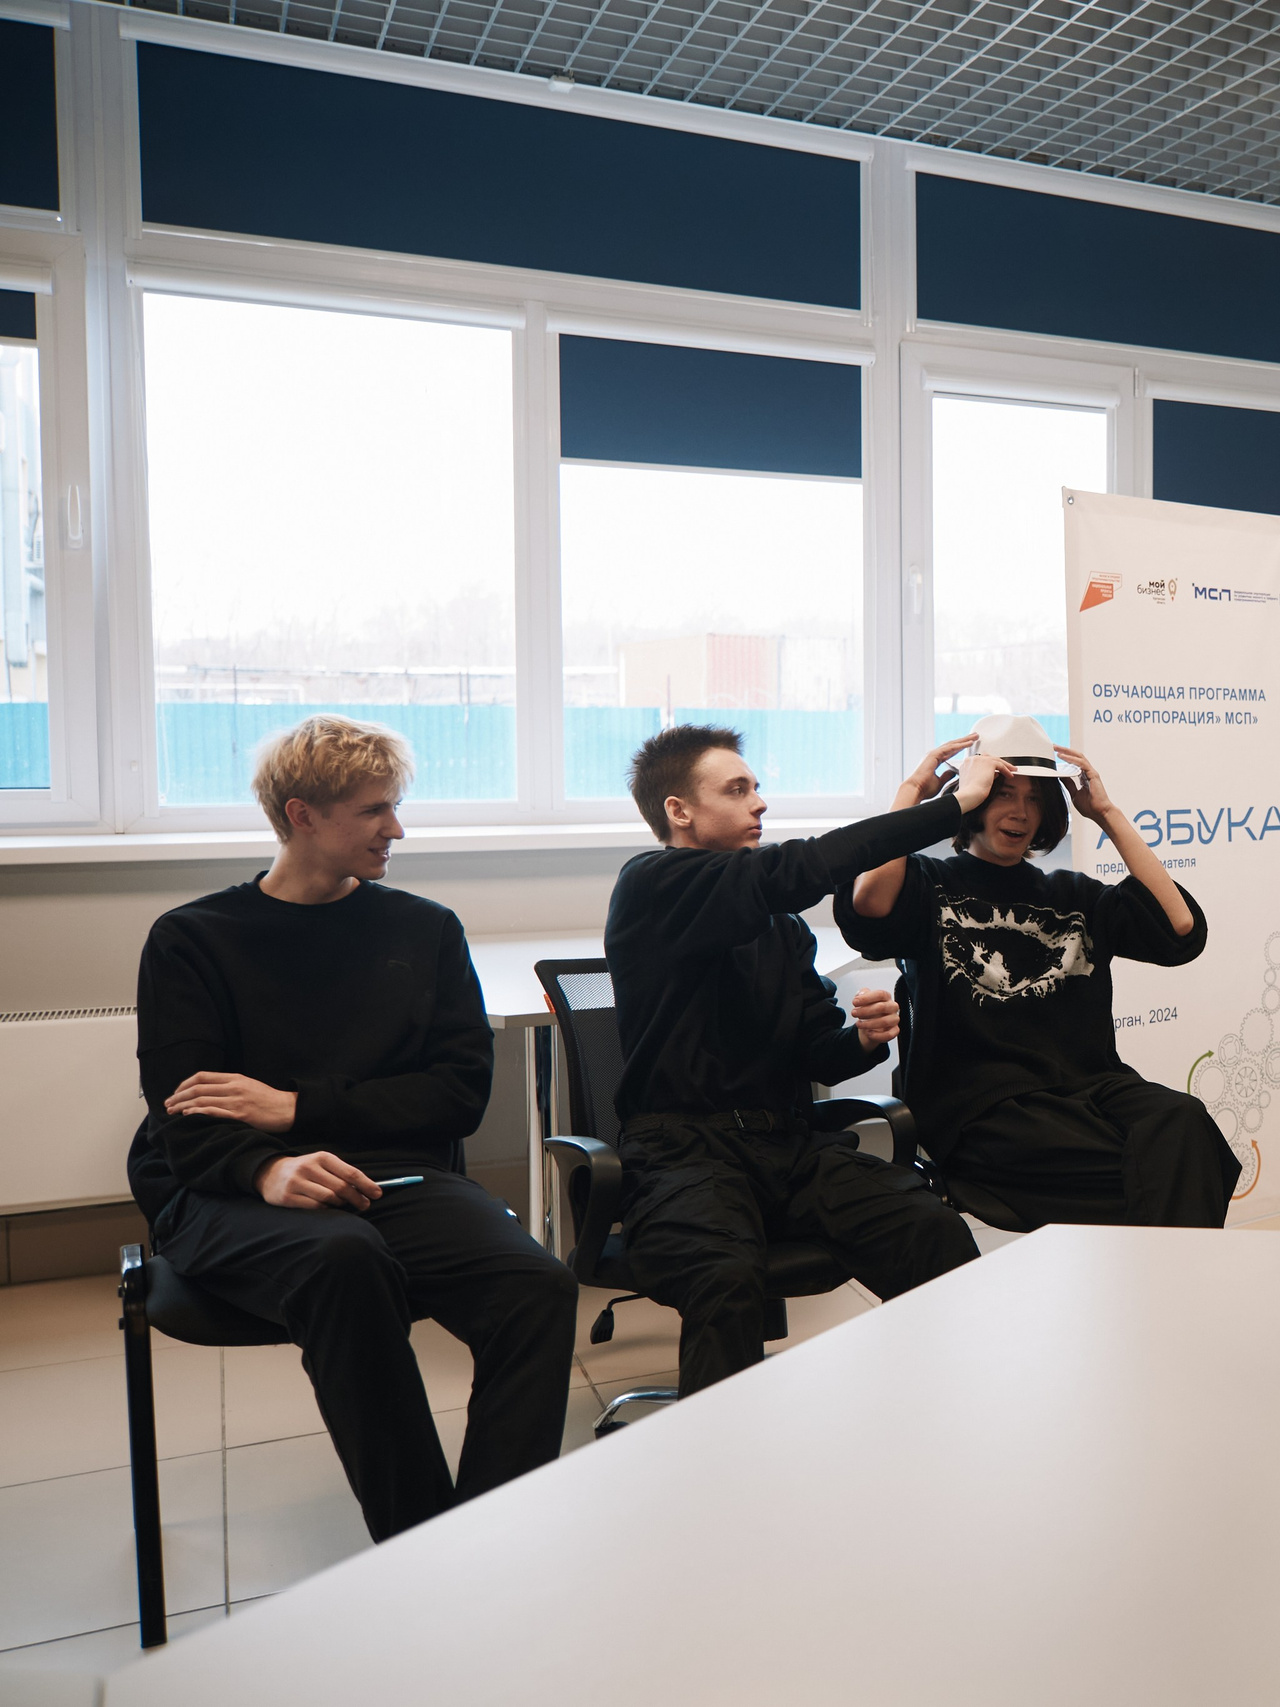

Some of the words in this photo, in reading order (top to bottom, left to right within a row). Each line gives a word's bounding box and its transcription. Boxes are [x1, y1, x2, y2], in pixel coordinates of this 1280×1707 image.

[1137, 584, 1165, 597] бизнес
[1149, 580, 1165, 589] мой
[1194, 586, 1231, 602] МСП
[1092, 683, 1185, 701] ОБУЧАЮЩАЯ
[1189, 687, 1267, 702] ПРОГРАММА
[1093, 709, 1113, 723] АО
[1117, 710, 1221, 727] «КОРПОРАЦИЯ»
[1225, 712, 1258, 725] МСП»
[1096, 857, 1197, 876] предмателя
[1113, 1015, 1145, 1032] рган,
[1149, 1006, 1178, 1024] 2024
